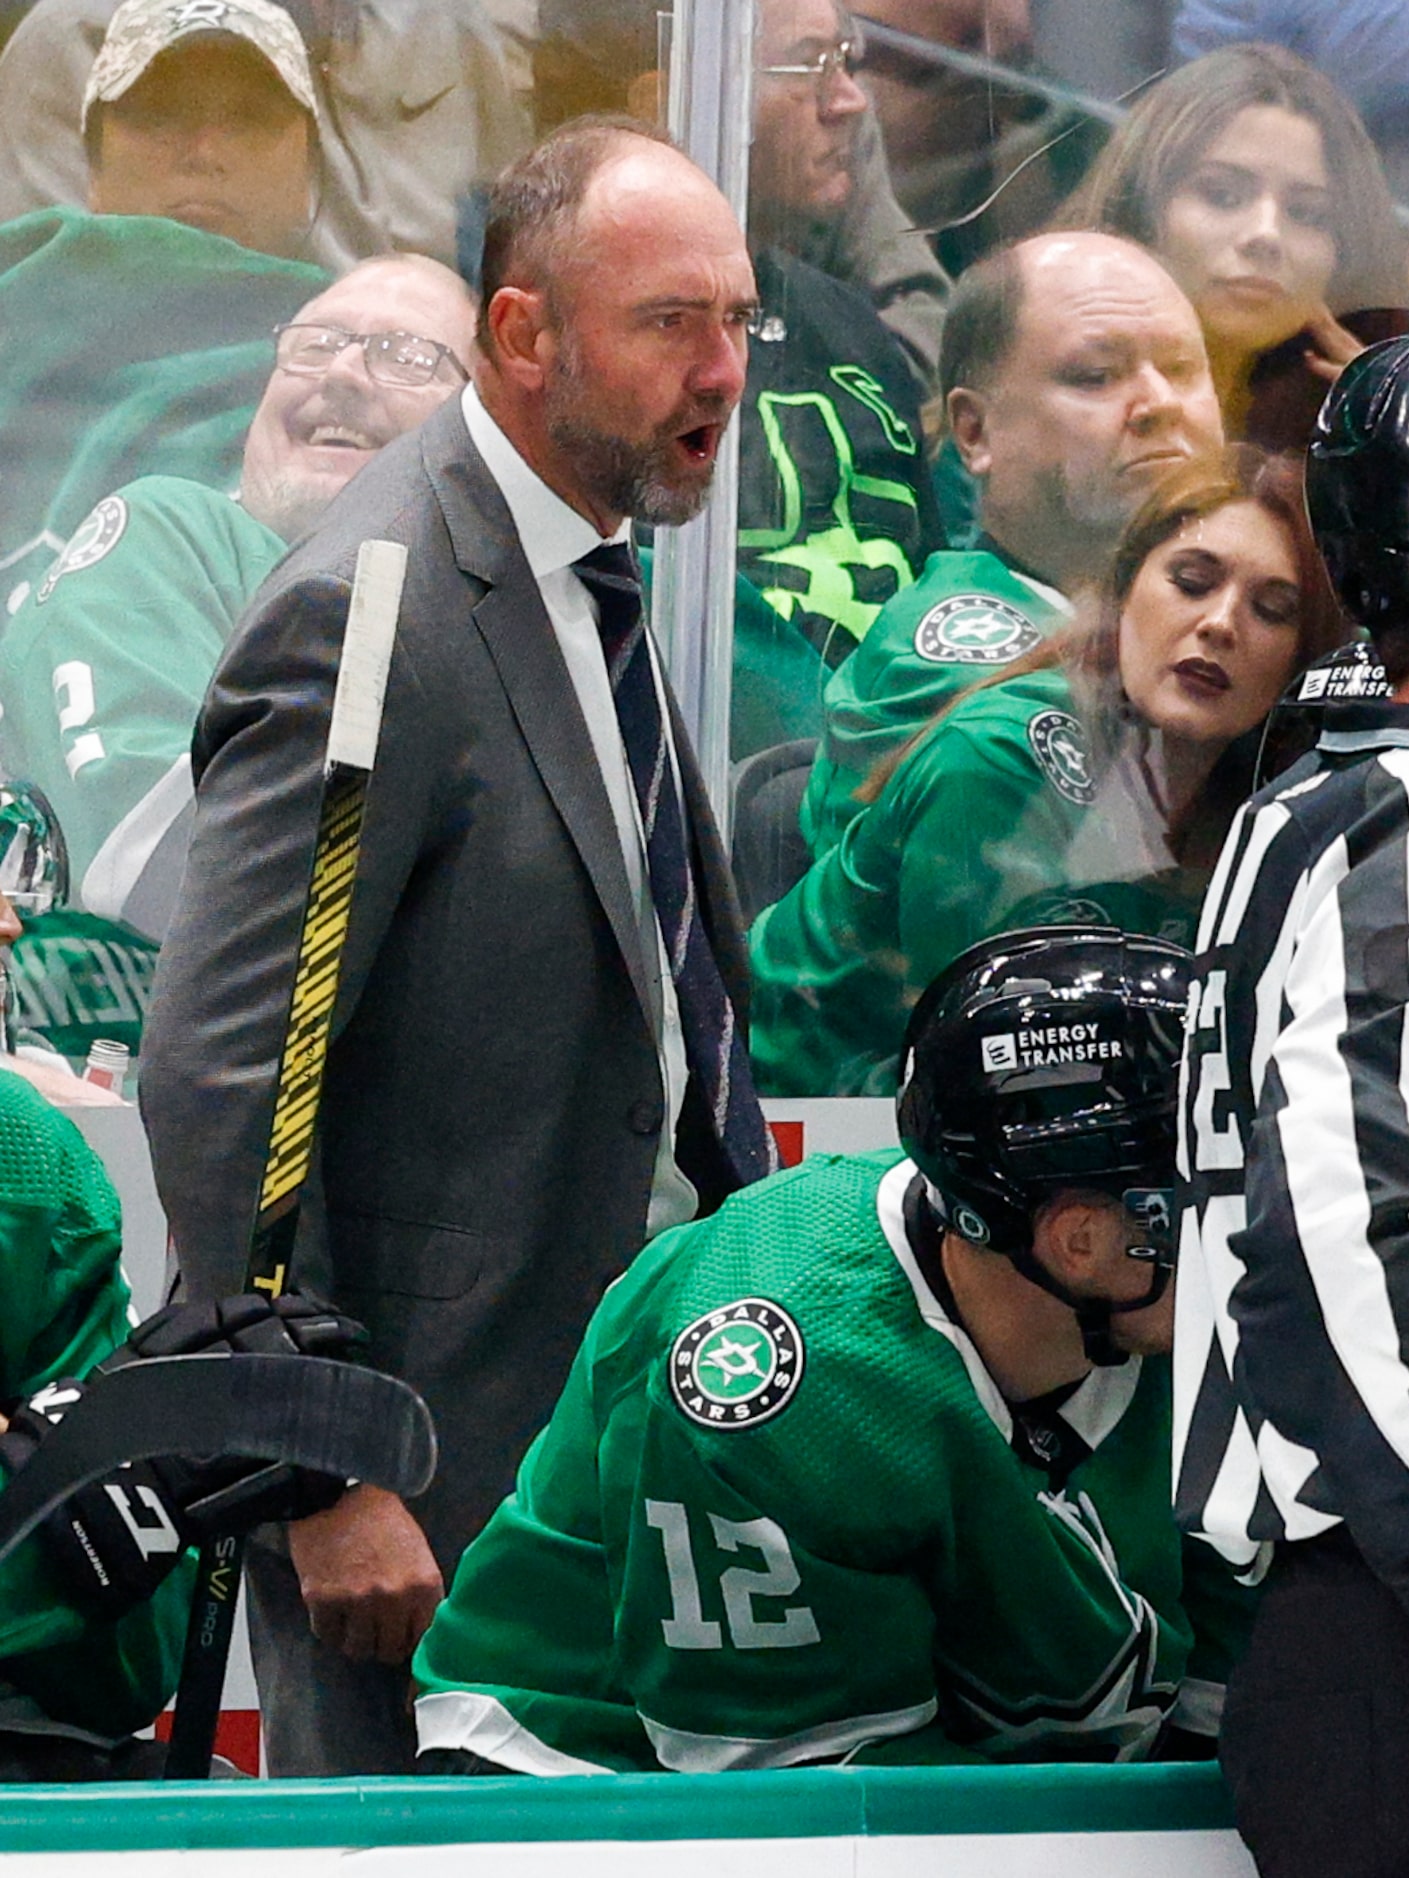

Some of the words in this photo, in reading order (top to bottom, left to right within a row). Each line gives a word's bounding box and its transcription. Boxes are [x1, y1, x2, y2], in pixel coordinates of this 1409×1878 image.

[1018, 1023, 1099, 1048] ENERGY
[1020, 1040, 1122, 1067] TRANSFER
[709, 1306, 794, 1390] DALLAS
[676, 1351, 751, 1420] STARS
[645, 1498, 821, 1649] 12
